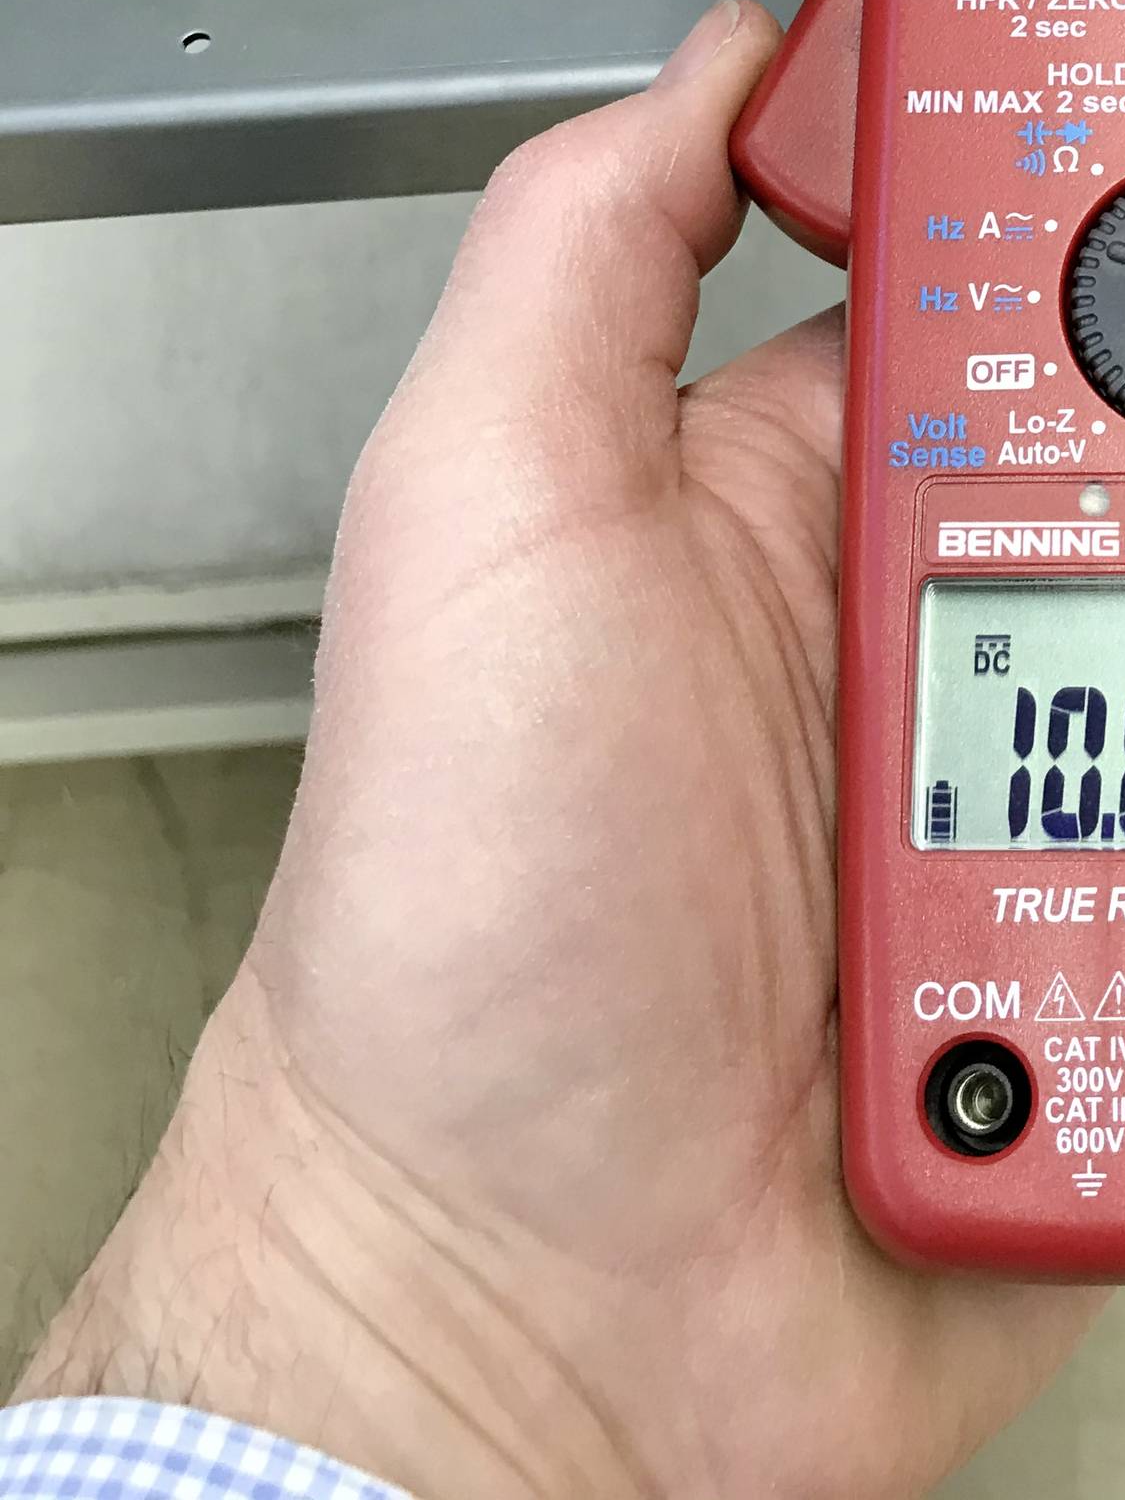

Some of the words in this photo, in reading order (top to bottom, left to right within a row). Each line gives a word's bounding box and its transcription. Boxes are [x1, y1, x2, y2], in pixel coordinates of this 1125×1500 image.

[1009, 15, 1028, 38] 2
[1035, 19, 1087, 38] sec
[906, 90, 963, 114] MIN
[973, 90, 1044, 114] MAX
[1056, 90, 1073, 114] 2
[927, 214, 965, 241] Hz
[918, 285, 960, 312] Hz
[970, 359, 1031, 385] OFF
[907, 411, 968, 440] Volt
[1008, 407, 1077, 435] Lo-Z
[888, 440, 987, 469] Sense
[997, 438, 1087, 465] Auto-V
[938, 523, 1120, 558] BENNING
[973, 649, 1012, 676] DC
[992, 886, 1098, 923] TRUE
[913, 980, 1021, 1021] COM
[1043, 1036, 1101, 1063] CAT
[1056, 1066, 1124, 1093] 300V
[1045, 1097, 1103, 1124] CAT
[1056, 1127, 1125, 1154] 600V
